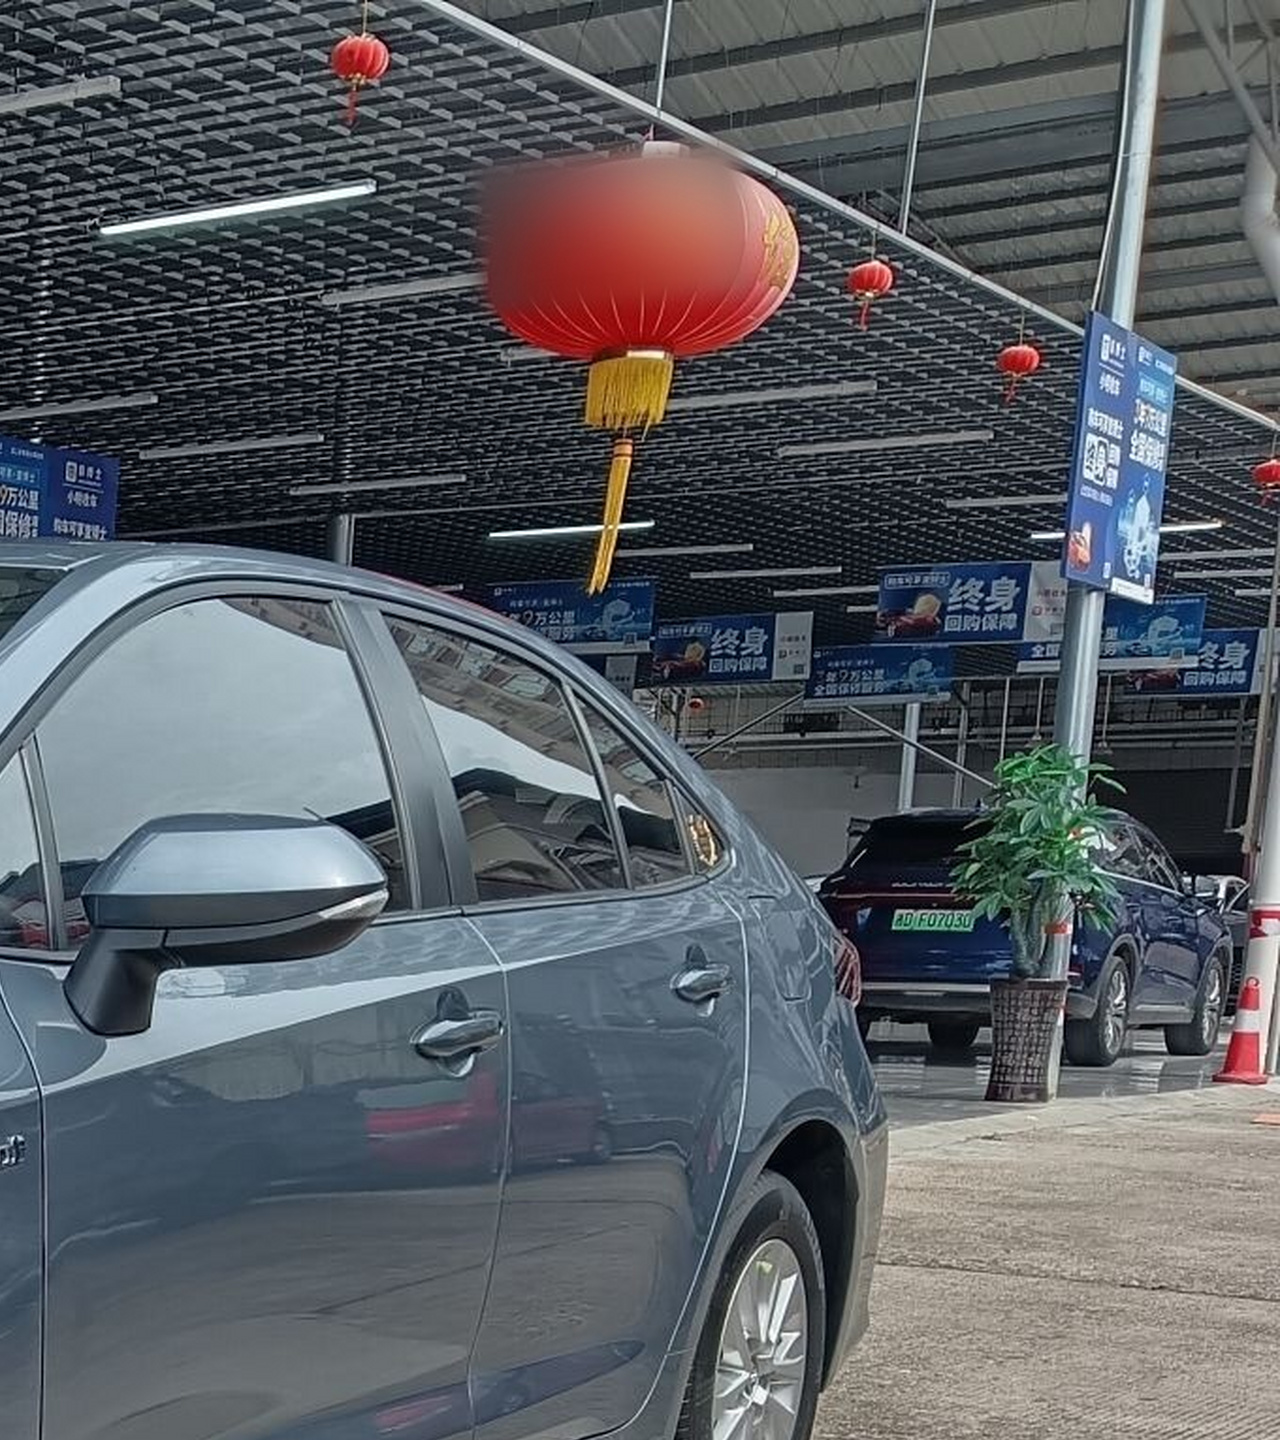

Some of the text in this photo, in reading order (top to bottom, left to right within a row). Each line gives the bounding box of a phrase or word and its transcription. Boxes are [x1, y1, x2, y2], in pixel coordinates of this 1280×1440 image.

[947, 576, 1022, 613] 终身
[943, 612, 1018, 633] 回购保障
[710, 627, 768, 657] 终身
[708, 656, 767, 674] 回购保障
